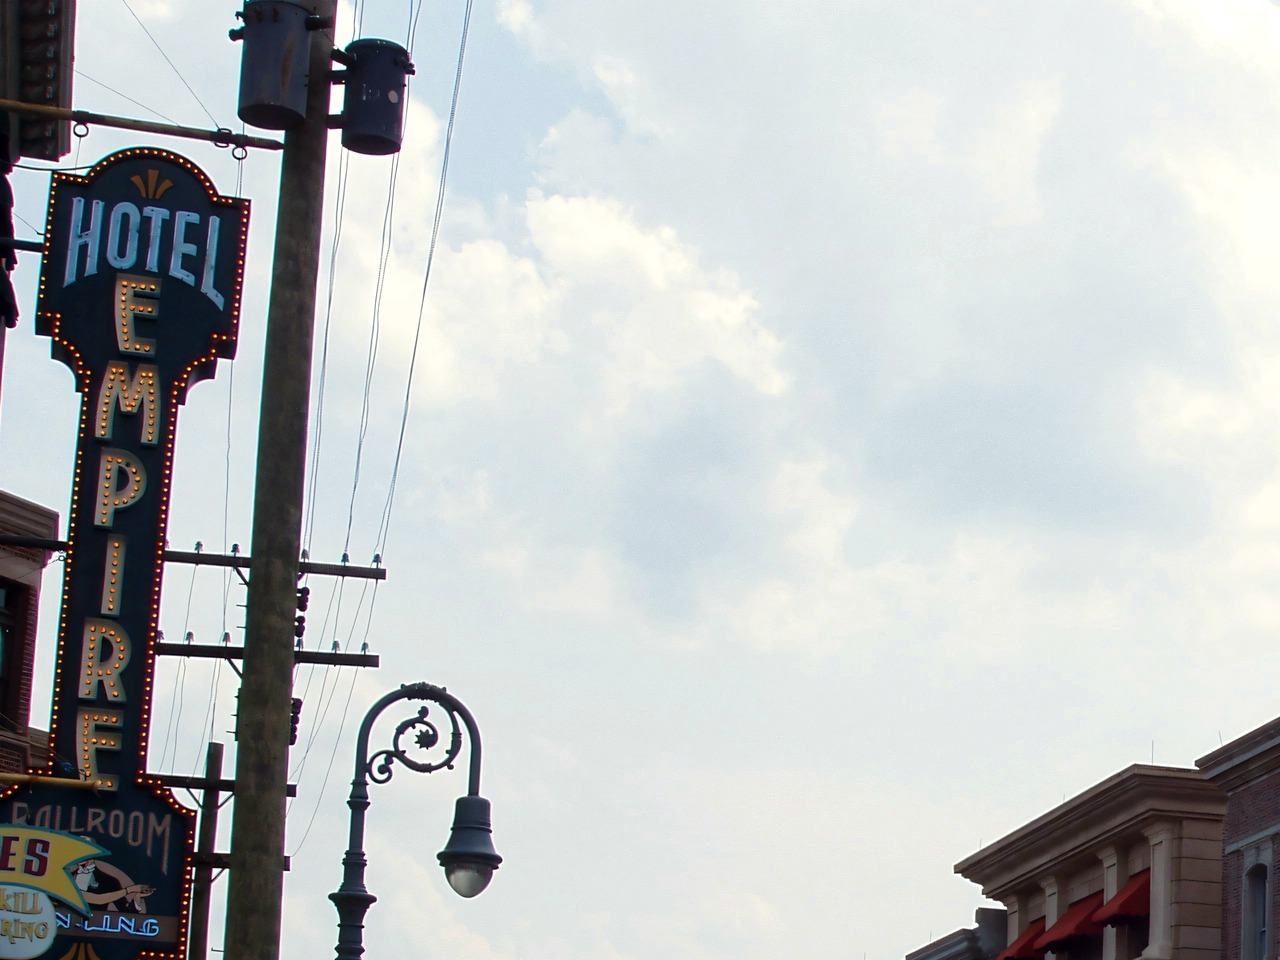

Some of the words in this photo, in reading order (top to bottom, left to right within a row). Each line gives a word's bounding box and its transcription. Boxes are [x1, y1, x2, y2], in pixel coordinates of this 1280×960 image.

[63, 196, 225, 312] HOTEL
[76, 273, 163, 792] EMPIRE
[11, 800, 172, 876] BALLROOM
